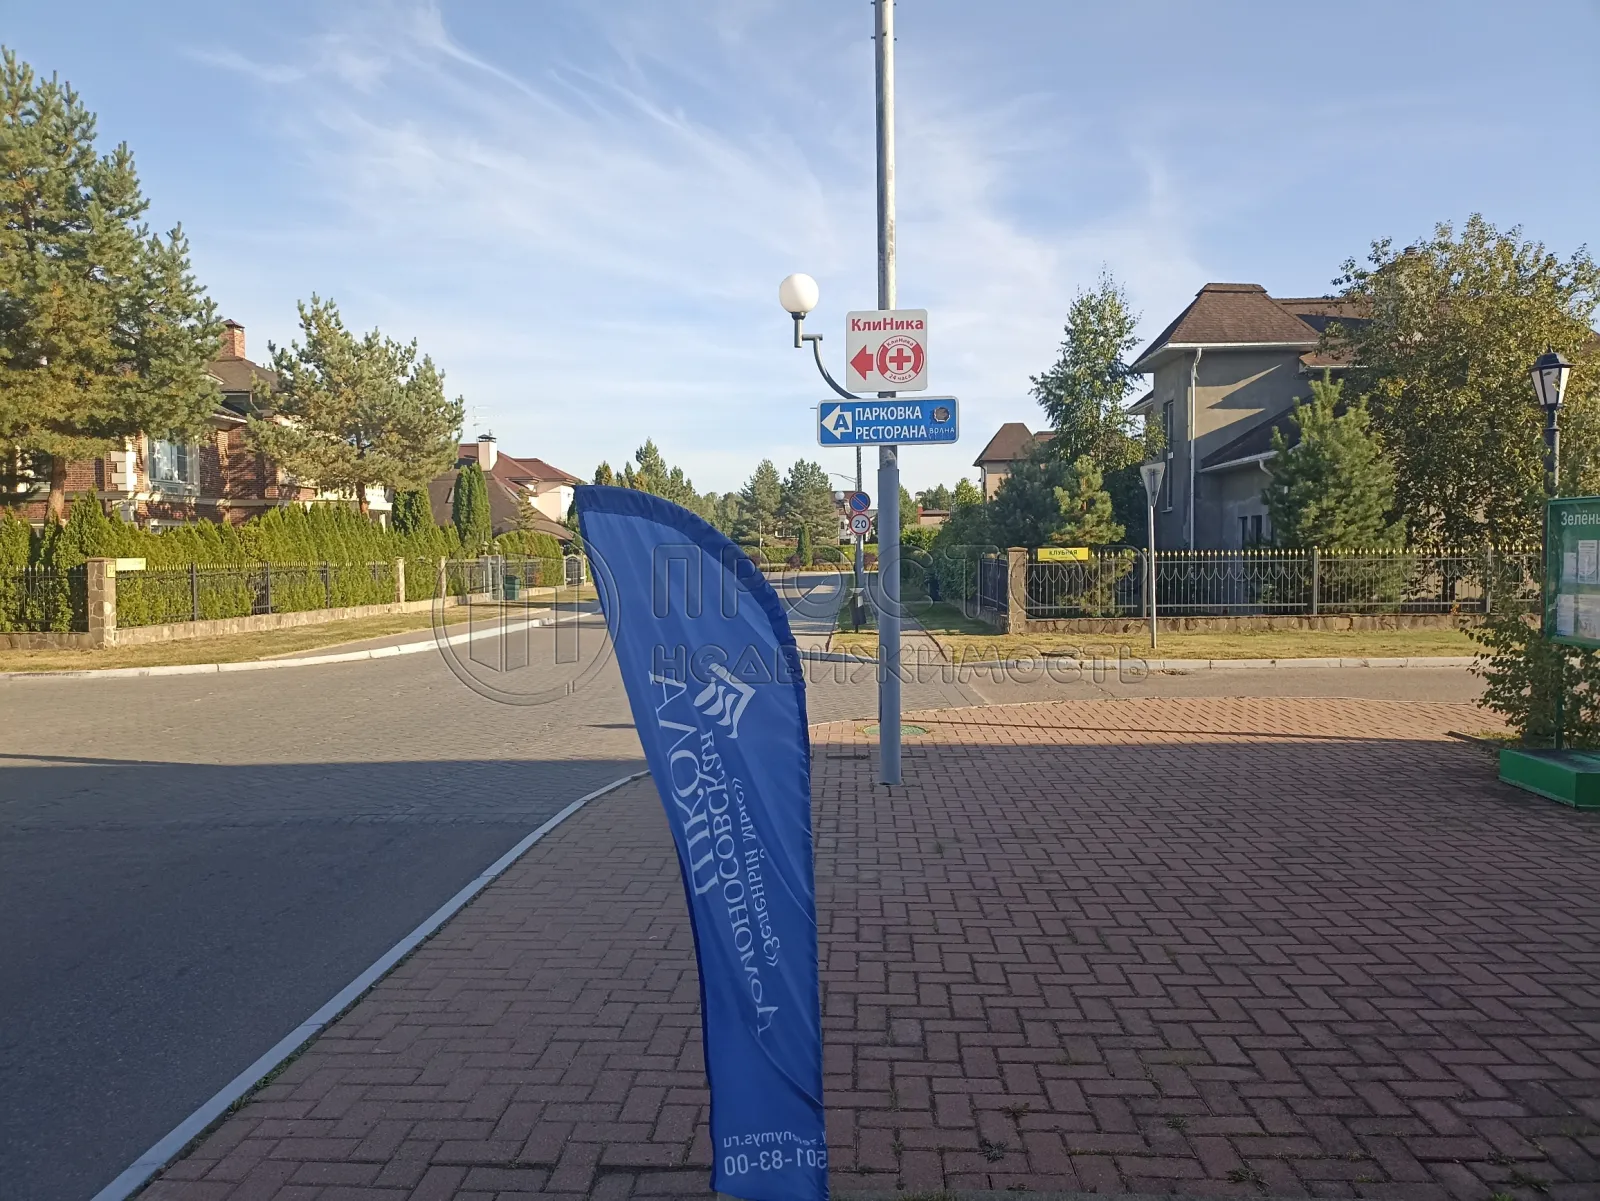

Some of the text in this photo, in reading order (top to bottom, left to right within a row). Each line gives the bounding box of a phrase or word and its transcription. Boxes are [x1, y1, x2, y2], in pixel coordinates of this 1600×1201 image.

[851, 317, 924, 332] КлиНика
[855, 405, 922, 421] ПАРКОВКА
[855, 424, 927, 440] РЕСТОРАНА
[855, 519, 867, 529] 20
